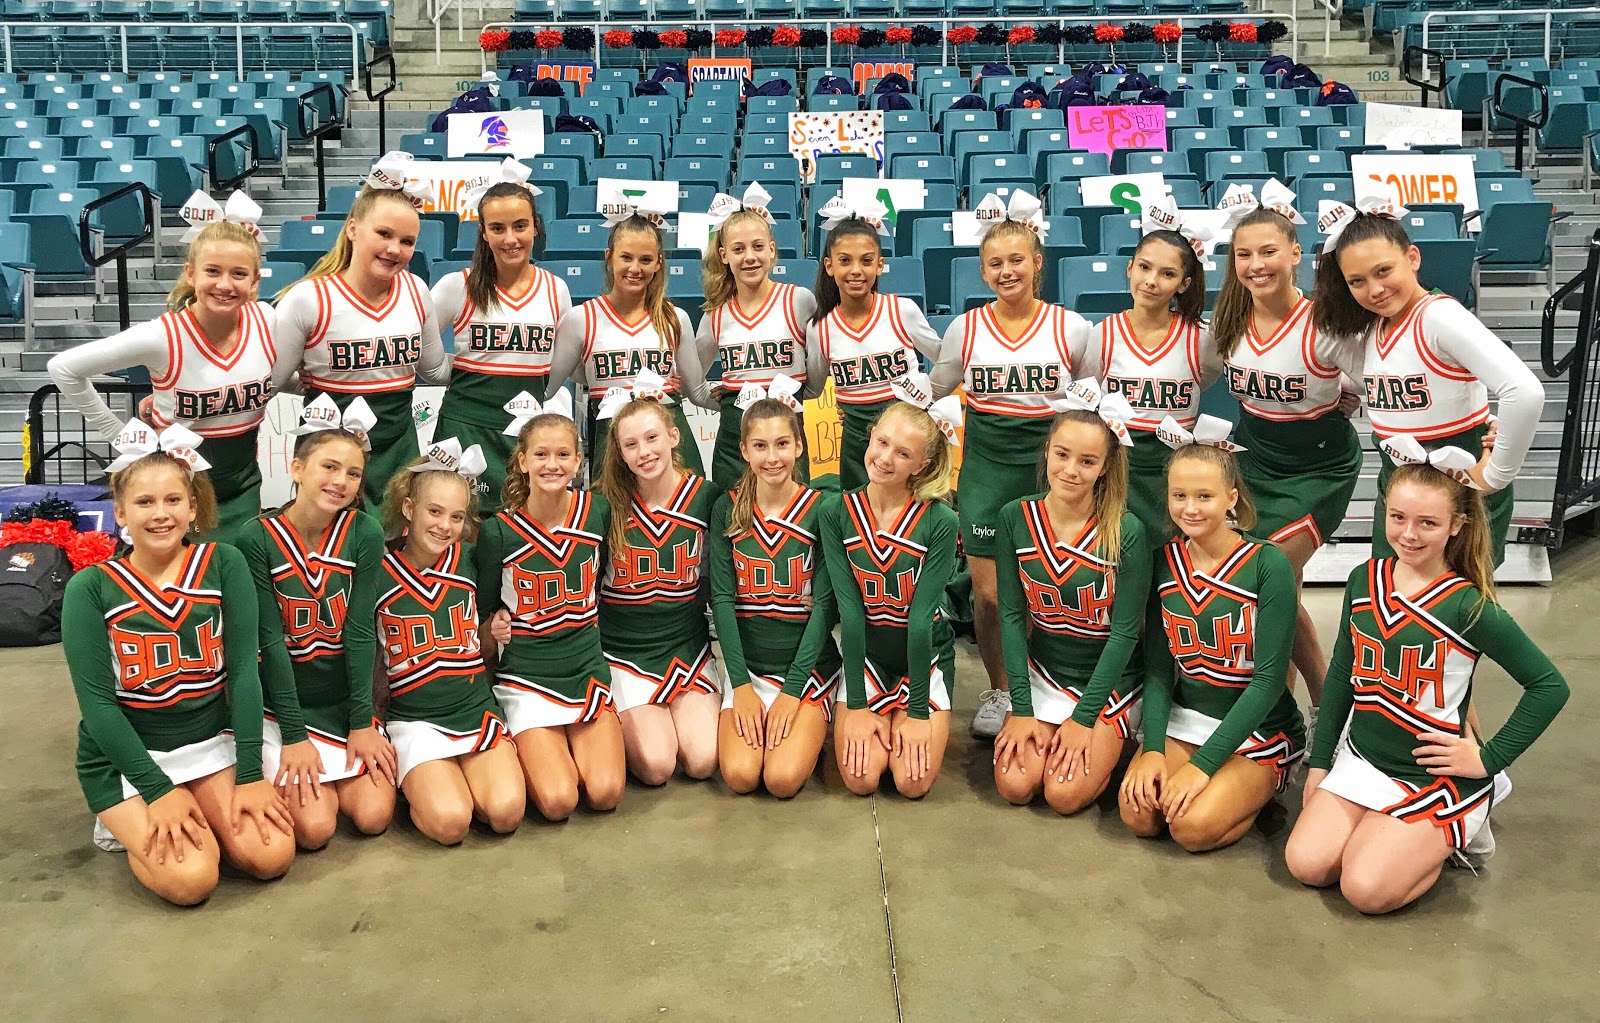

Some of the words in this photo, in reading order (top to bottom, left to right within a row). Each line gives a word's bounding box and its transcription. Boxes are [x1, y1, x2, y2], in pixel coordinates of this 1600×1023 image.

[455, 80, 476, 91] 10
[1367, 71, 1389, 82] 103
[602, 203, 627, 215] BDJH
[1221, 192, 1252, 210] BDJH
[183, 205, 215, 221] BDJH
[975, 208, 1000, 220] BDJH
[1149, 205, 1174, 225] BDJH
[1318, 205, 1346, 233] BDJH
[468, 322, 554, 353] BEARS
[327, 333, 421, 372] BEARS
[719, 339, 795, 373] BEARS
[592, 349, 674, 380] BEARS
[831, 347, 910, 387] BEARS
[901, 377, 927, 402] BDJH
[969, 362, 1062, 396] BEARS
[174, 373, 273, 421] BEARS
[1066, 381, 1096, 403] BDJH
[1363, 373, 1433, 412] EARS
[304, 406, 336, 422] BDJH
[113, 432, 147, 446] BDJH
[1156, 426, 1182, 444] BDJH
[428, 445, 458, 468] BDJH
[972, 524, 996, 539] Taylor
[1350, 622, 1449, 709] DJH
